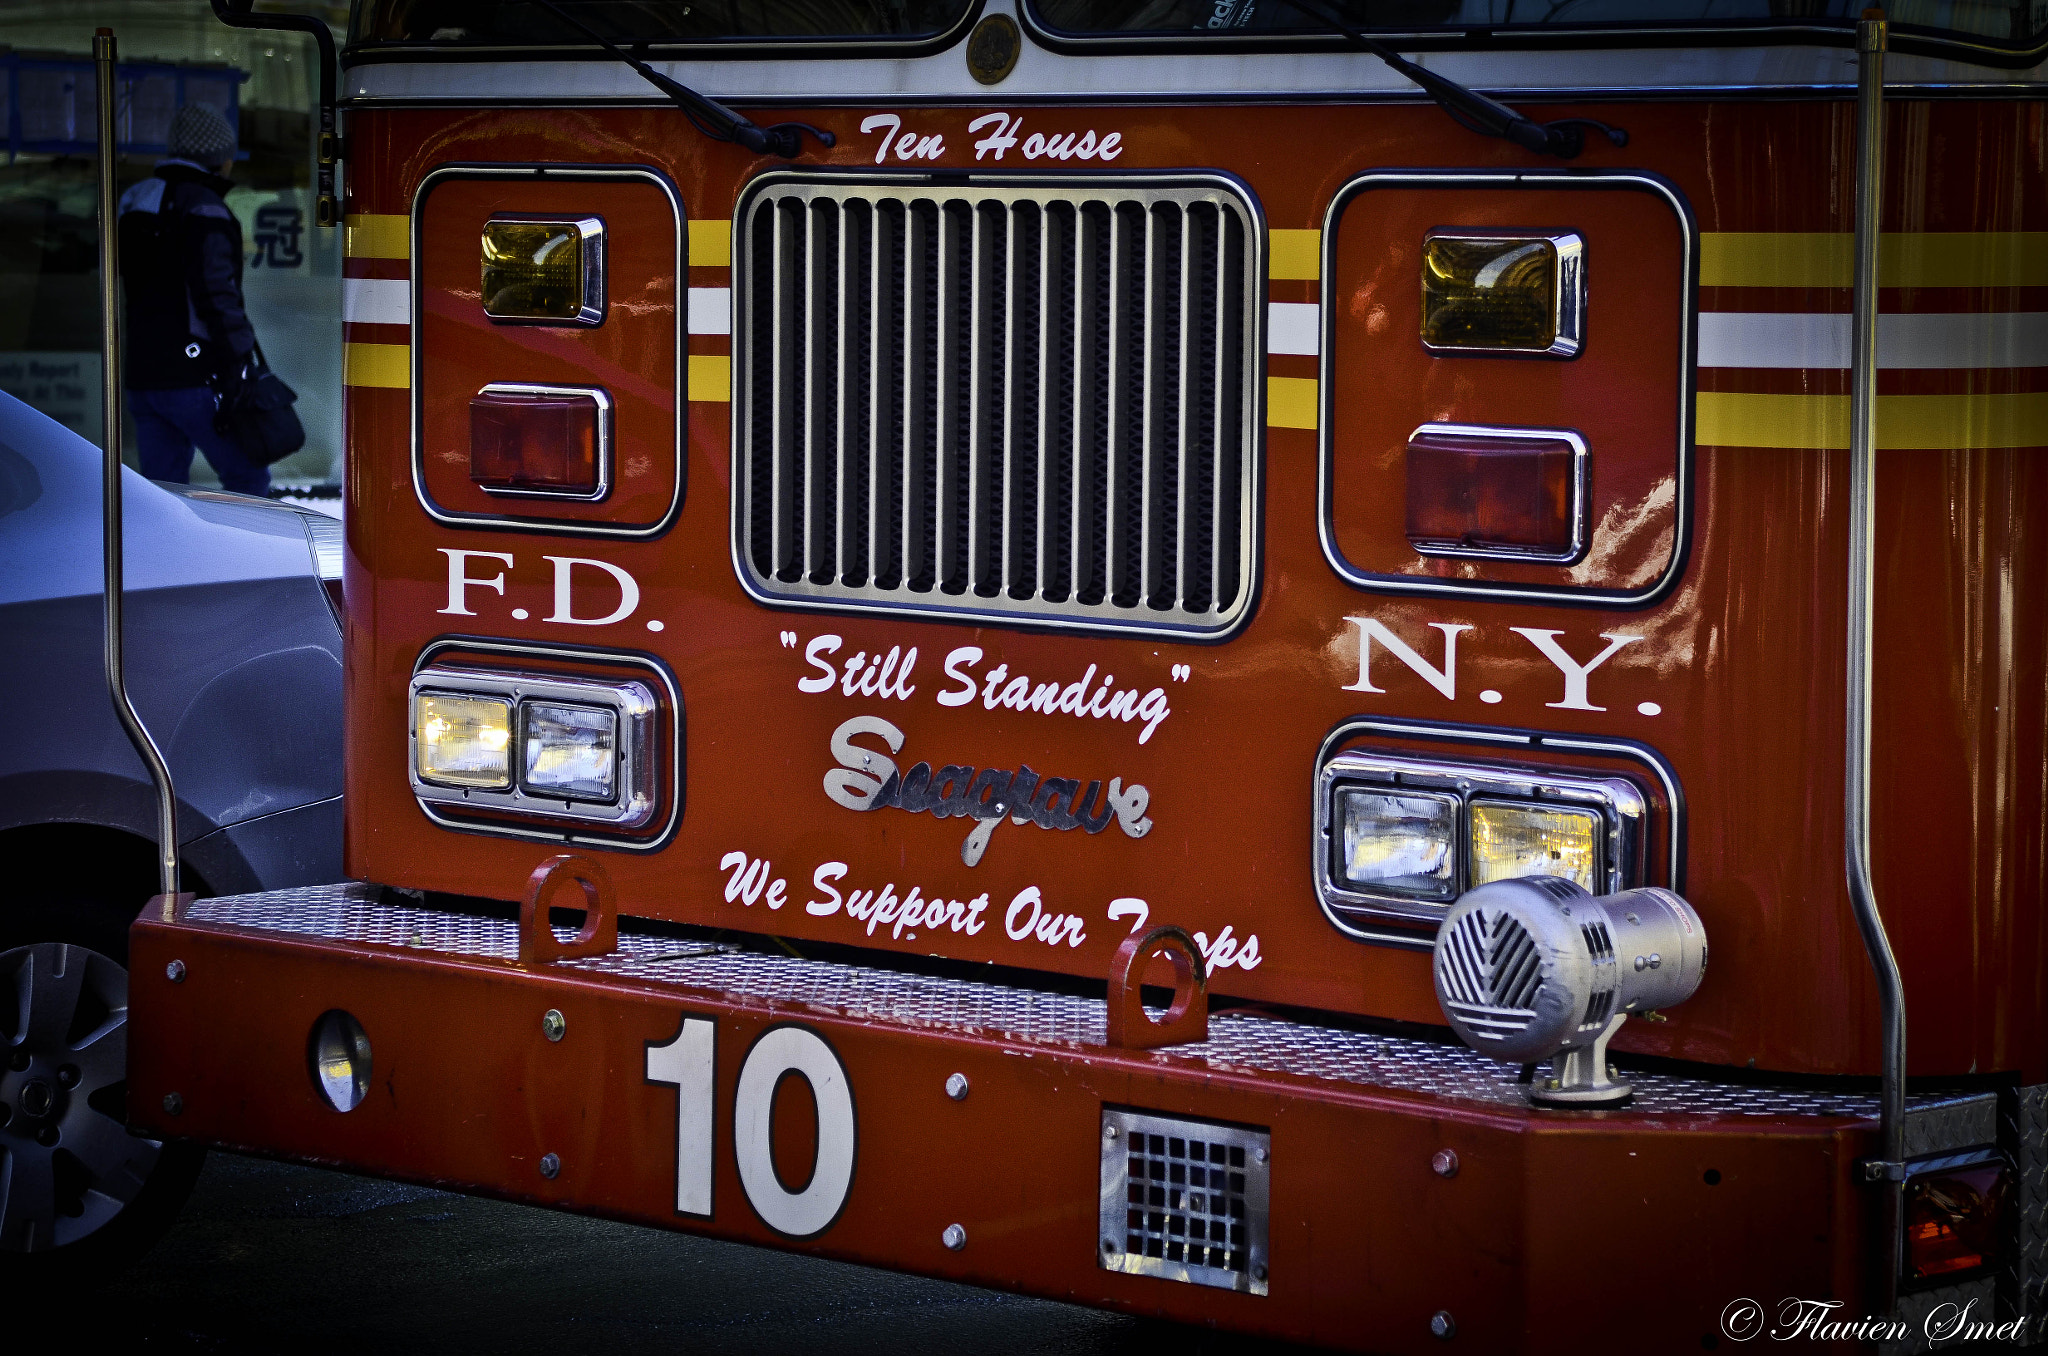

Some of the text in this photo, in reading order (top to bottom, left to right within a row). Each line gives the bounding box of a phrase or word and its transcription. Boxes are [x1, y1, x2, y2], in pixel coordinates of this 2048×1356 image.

[861, 112, 1123, 164] Ten House
[437, 549, 664, 631] F.D.
[780, 630, 1191, 745] "Still Standing"
[1342, 617, 1661, 715] N.Y.
[822, 715, 1154, 868] Seagrave
[720, 851, 1262, 979] We Support Our Tops
[646, 1017, 855, 1236] 10
